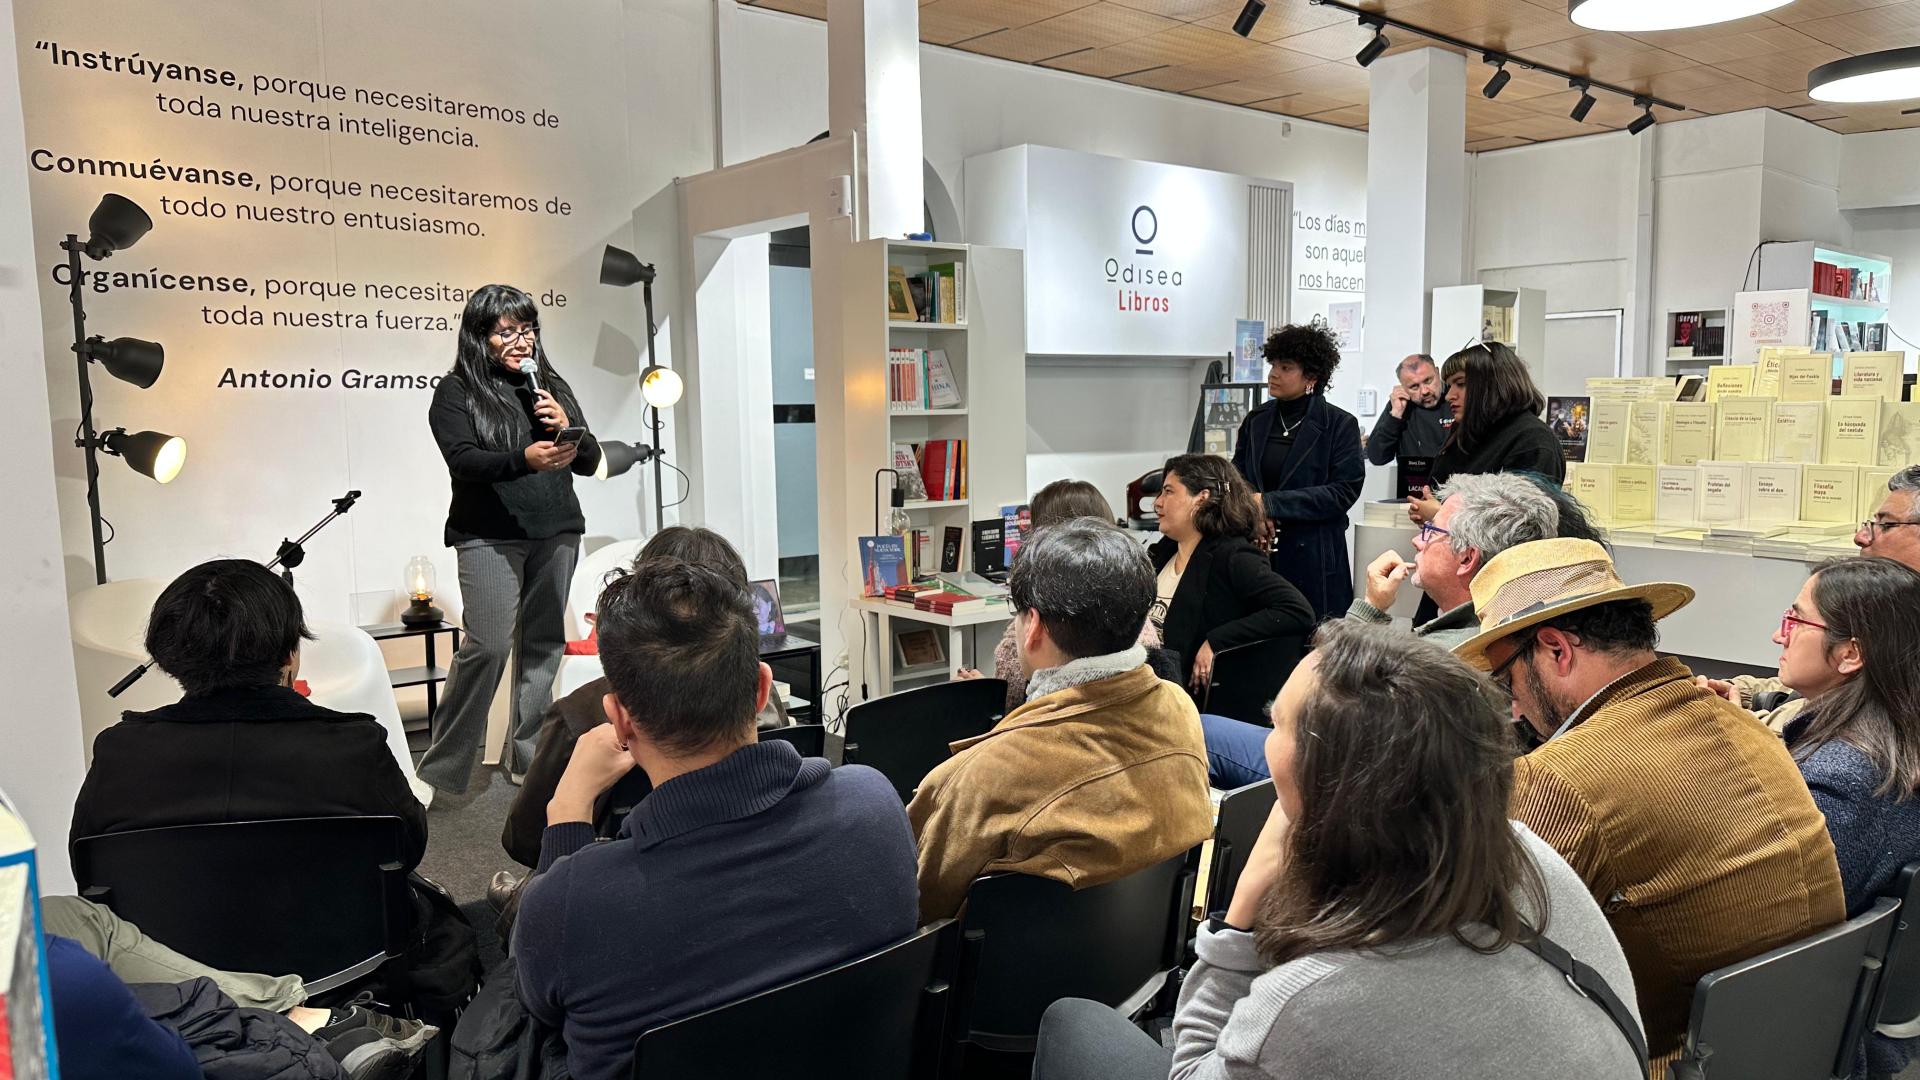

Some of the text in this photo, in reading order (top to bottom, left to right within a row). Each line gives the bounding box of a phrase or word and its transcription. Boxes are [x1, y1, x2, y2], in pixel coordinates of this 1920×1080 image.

[35, 41, 559, 128] “Instrúyanse, porque necesitaremos de
[156, 93, 479, 147] toda nuestra inteligencia.
[31, 149, 572, 215] Conmuévanse, porque necesitaremos de
[160, 196, 485, 237] todo nuestro entusiasmo.
[1325, 214, 1350, 234] días
[1305, 245, 1366, 267] son aquel
[52, 264, 567, 309] Organícense, porque necesitar de
[1299, 271, 1364, 291] nos hacen
[1119, 290, 1169, 312] Libros
[201, 305, 263, 325] toda
[273, 311, 367, 329] nuestra
[217, 368, 453, 391] Antonio Gramsc
